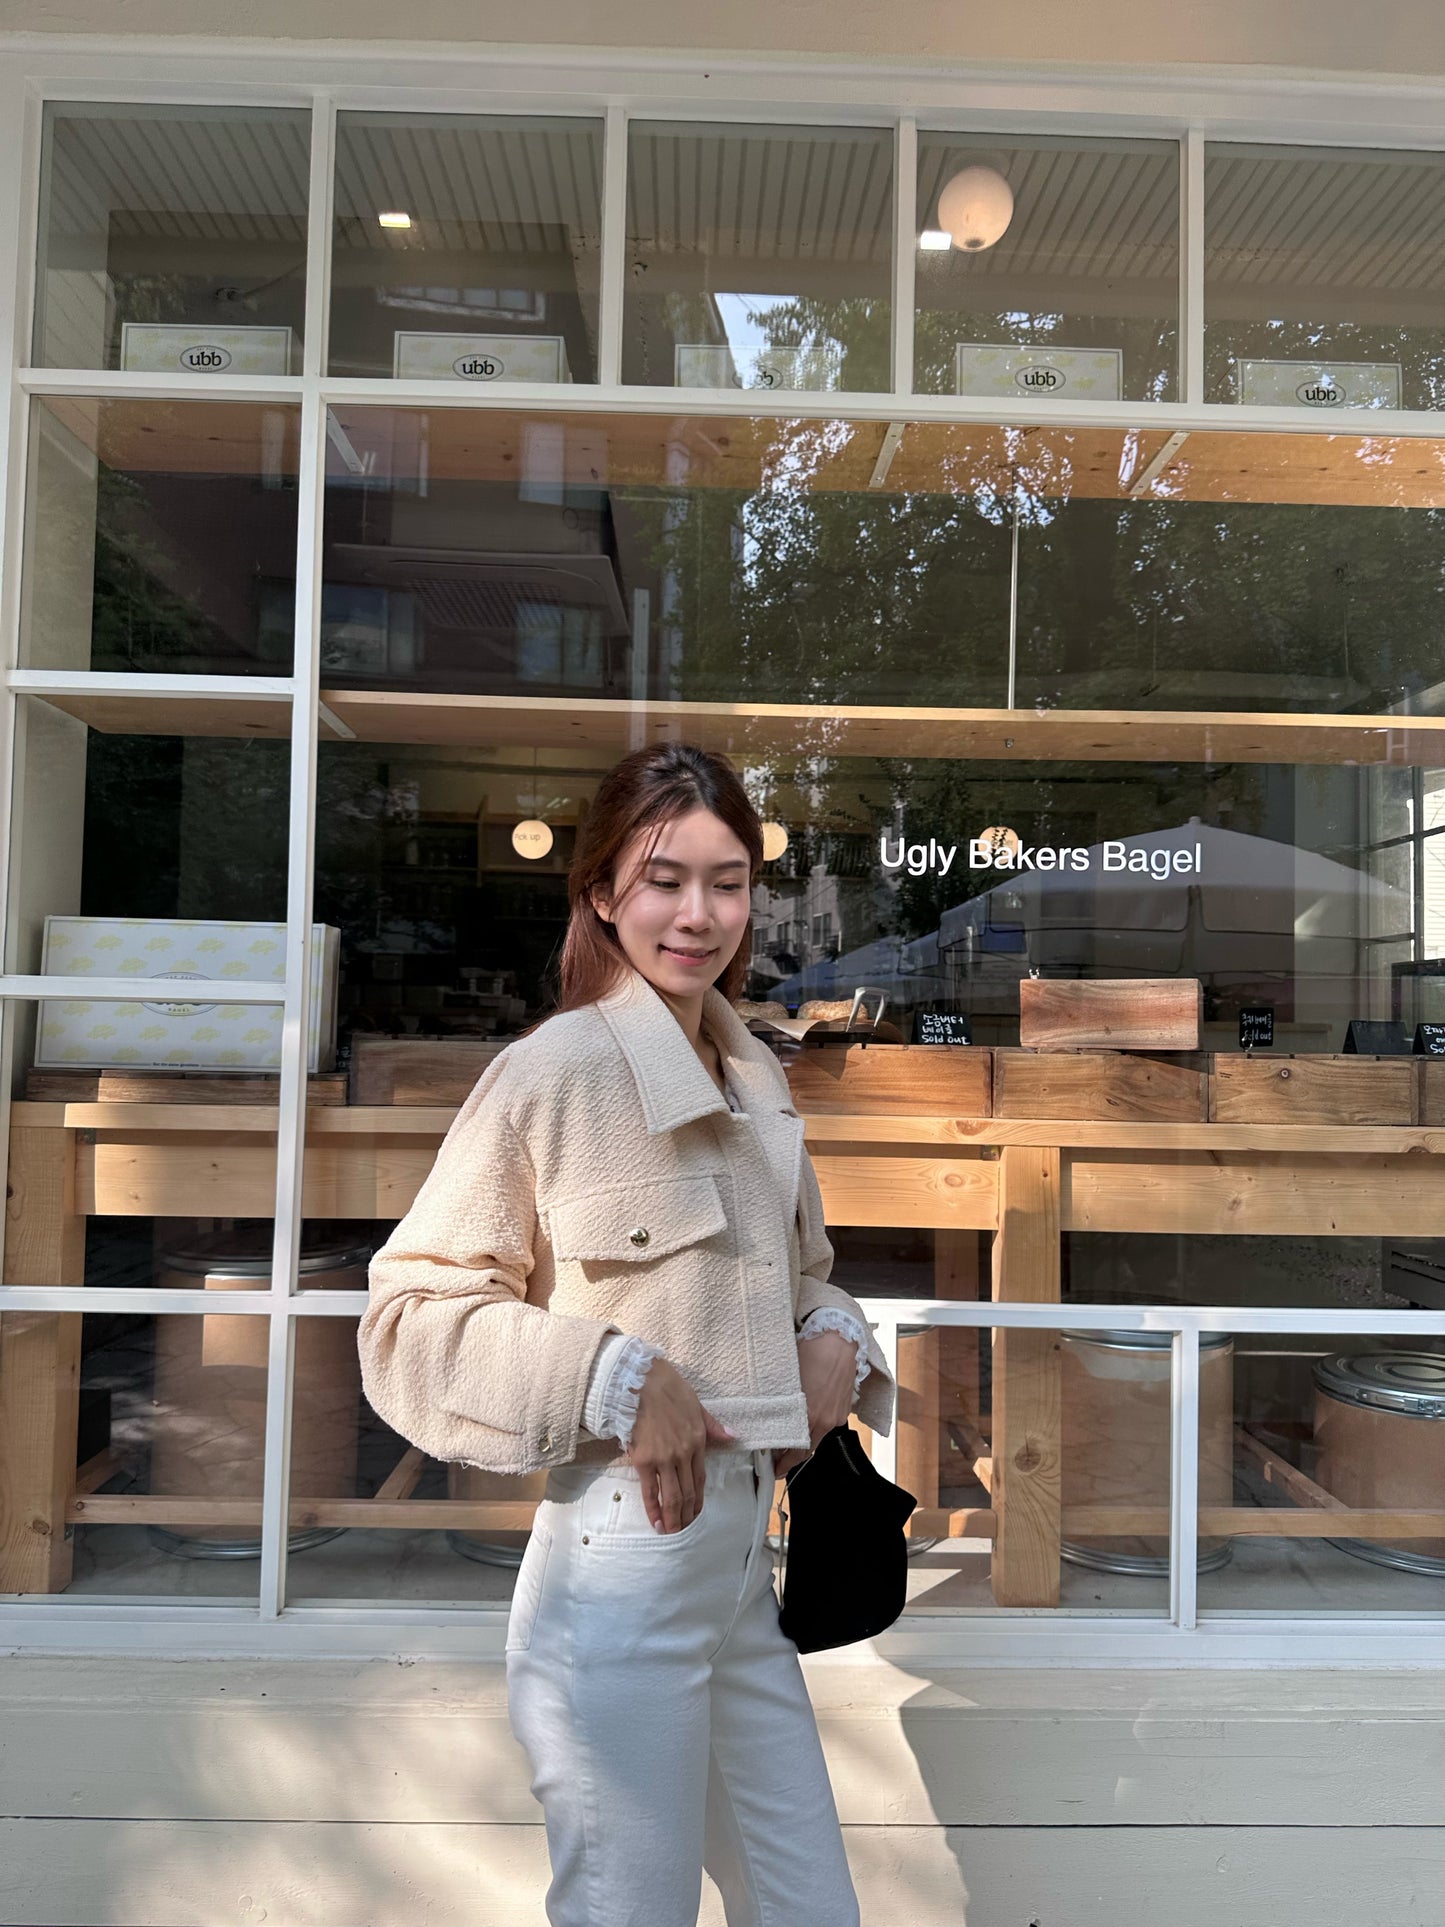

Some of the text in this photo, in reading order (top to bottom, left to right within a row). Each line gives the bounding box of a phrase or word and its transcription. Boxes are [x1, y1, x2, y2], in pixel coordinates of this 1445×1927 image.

[189, 351, 222, 366] ubb
[462, 360, 495, 375] ubb
[1024, 371, 1057, 386] ubb
[1304, 387, 1337, 401] ubb
[530, 834, 541, 842] up
[880, 837, 1201, 880] Ugly Bakers Bagel
[921, 1035, 944, 1044] Sold
